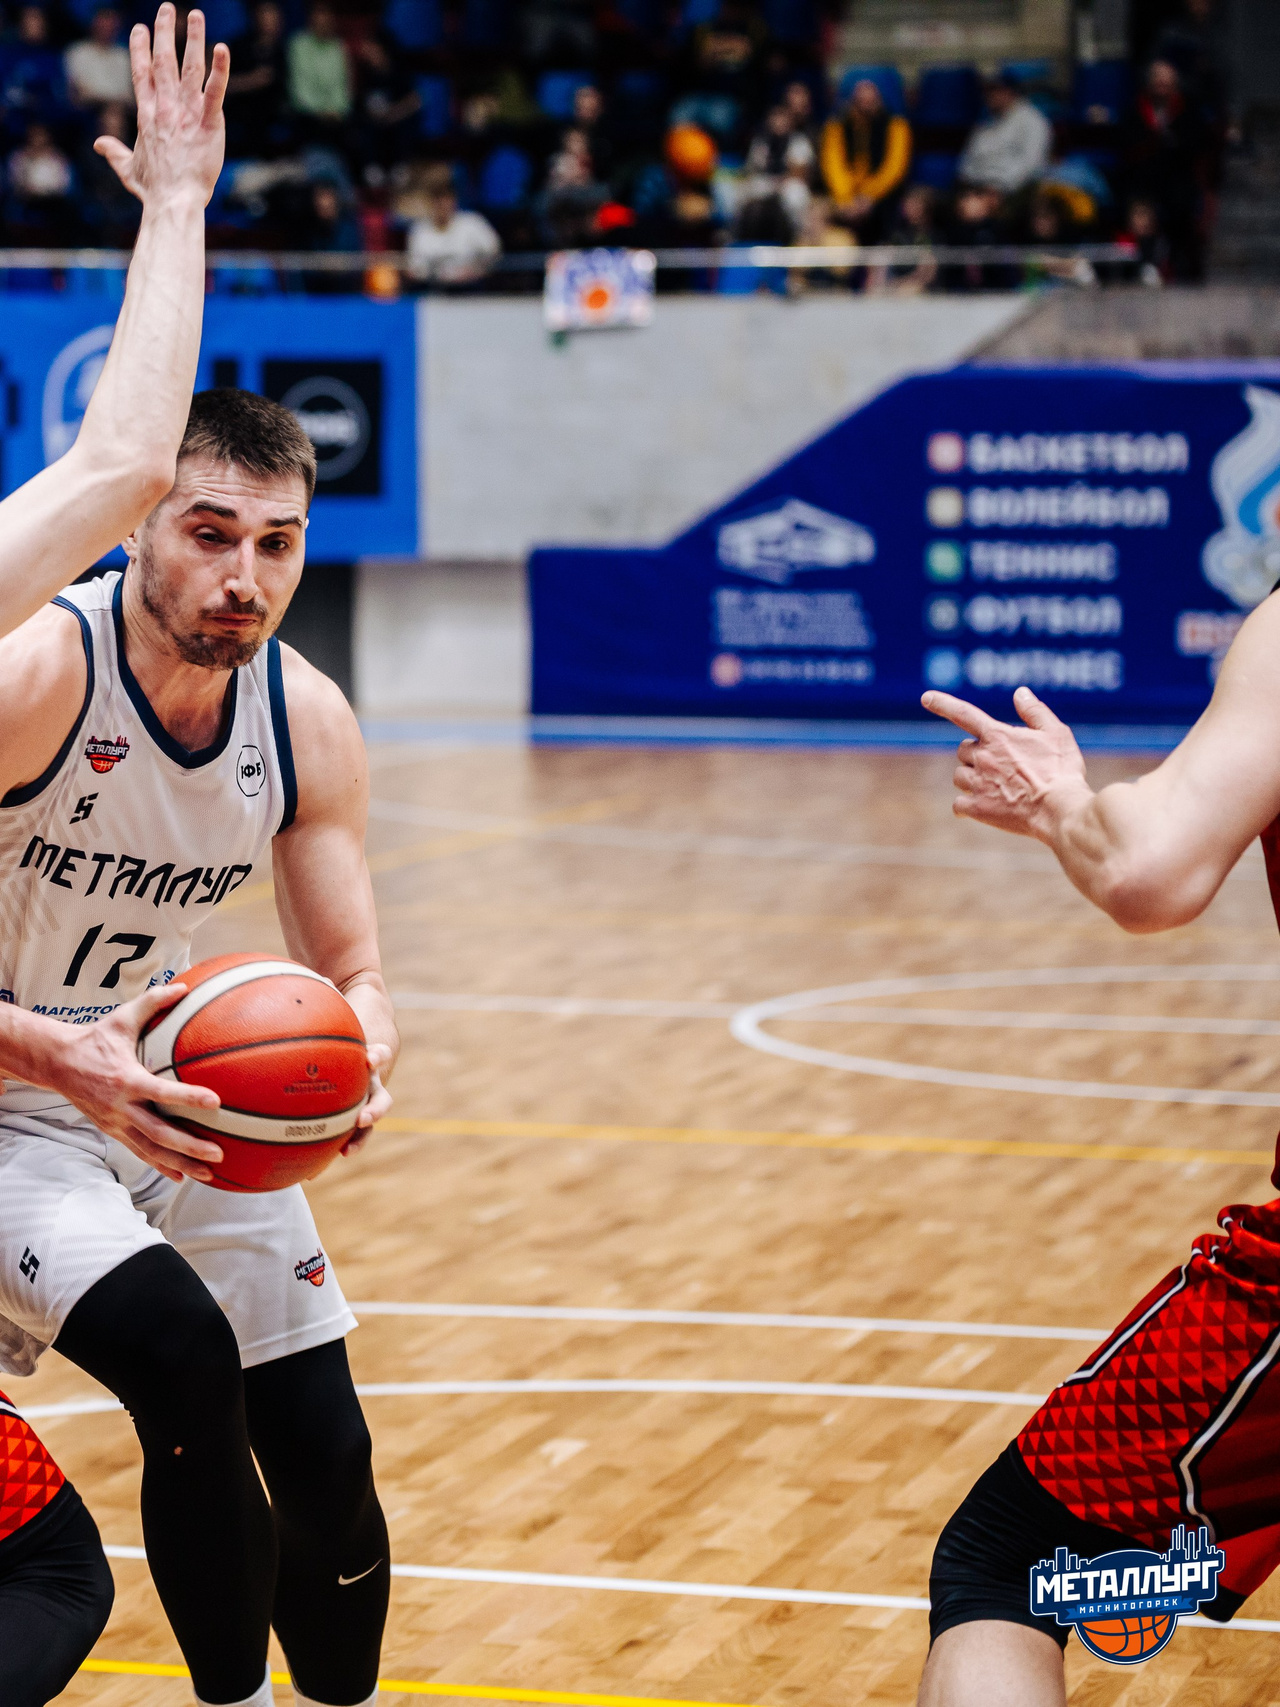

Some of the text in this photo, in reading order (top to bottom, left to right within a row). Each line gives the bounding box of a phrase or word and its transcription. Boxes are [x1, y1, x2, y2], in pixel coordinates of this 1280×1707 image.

[970, 432, 1190, 474] БАСКЕТБОЛ
[970, 481, 1169, 528] ВОЛЕЙБОЛ
[970, 540, 1117, 582] ТЕННИС
[966, 595, 1122, 637] ФУТБОЛ
[966, 650, 1123, 691] ФИТНЕС
[63, 923, 157, 989] 17
